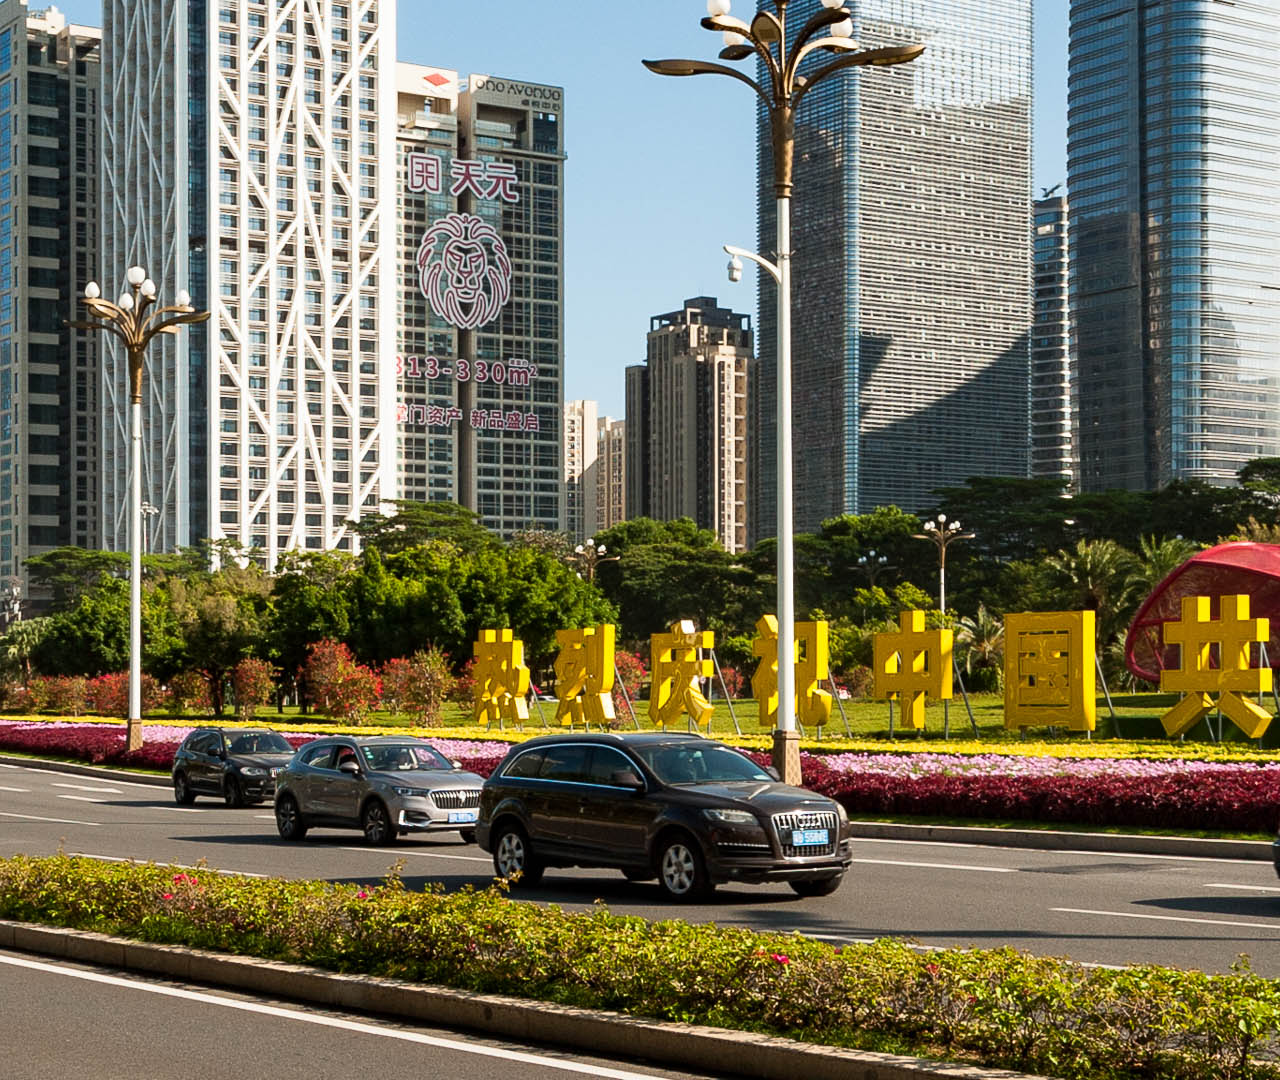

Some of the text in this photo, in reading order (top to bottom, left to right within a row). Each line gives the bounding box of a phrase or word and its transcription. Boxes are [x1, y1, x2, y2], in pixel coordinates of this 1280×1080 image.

[450, 160, 519, 203] 天元
[471, 409, 540, 431] 新品盛启
